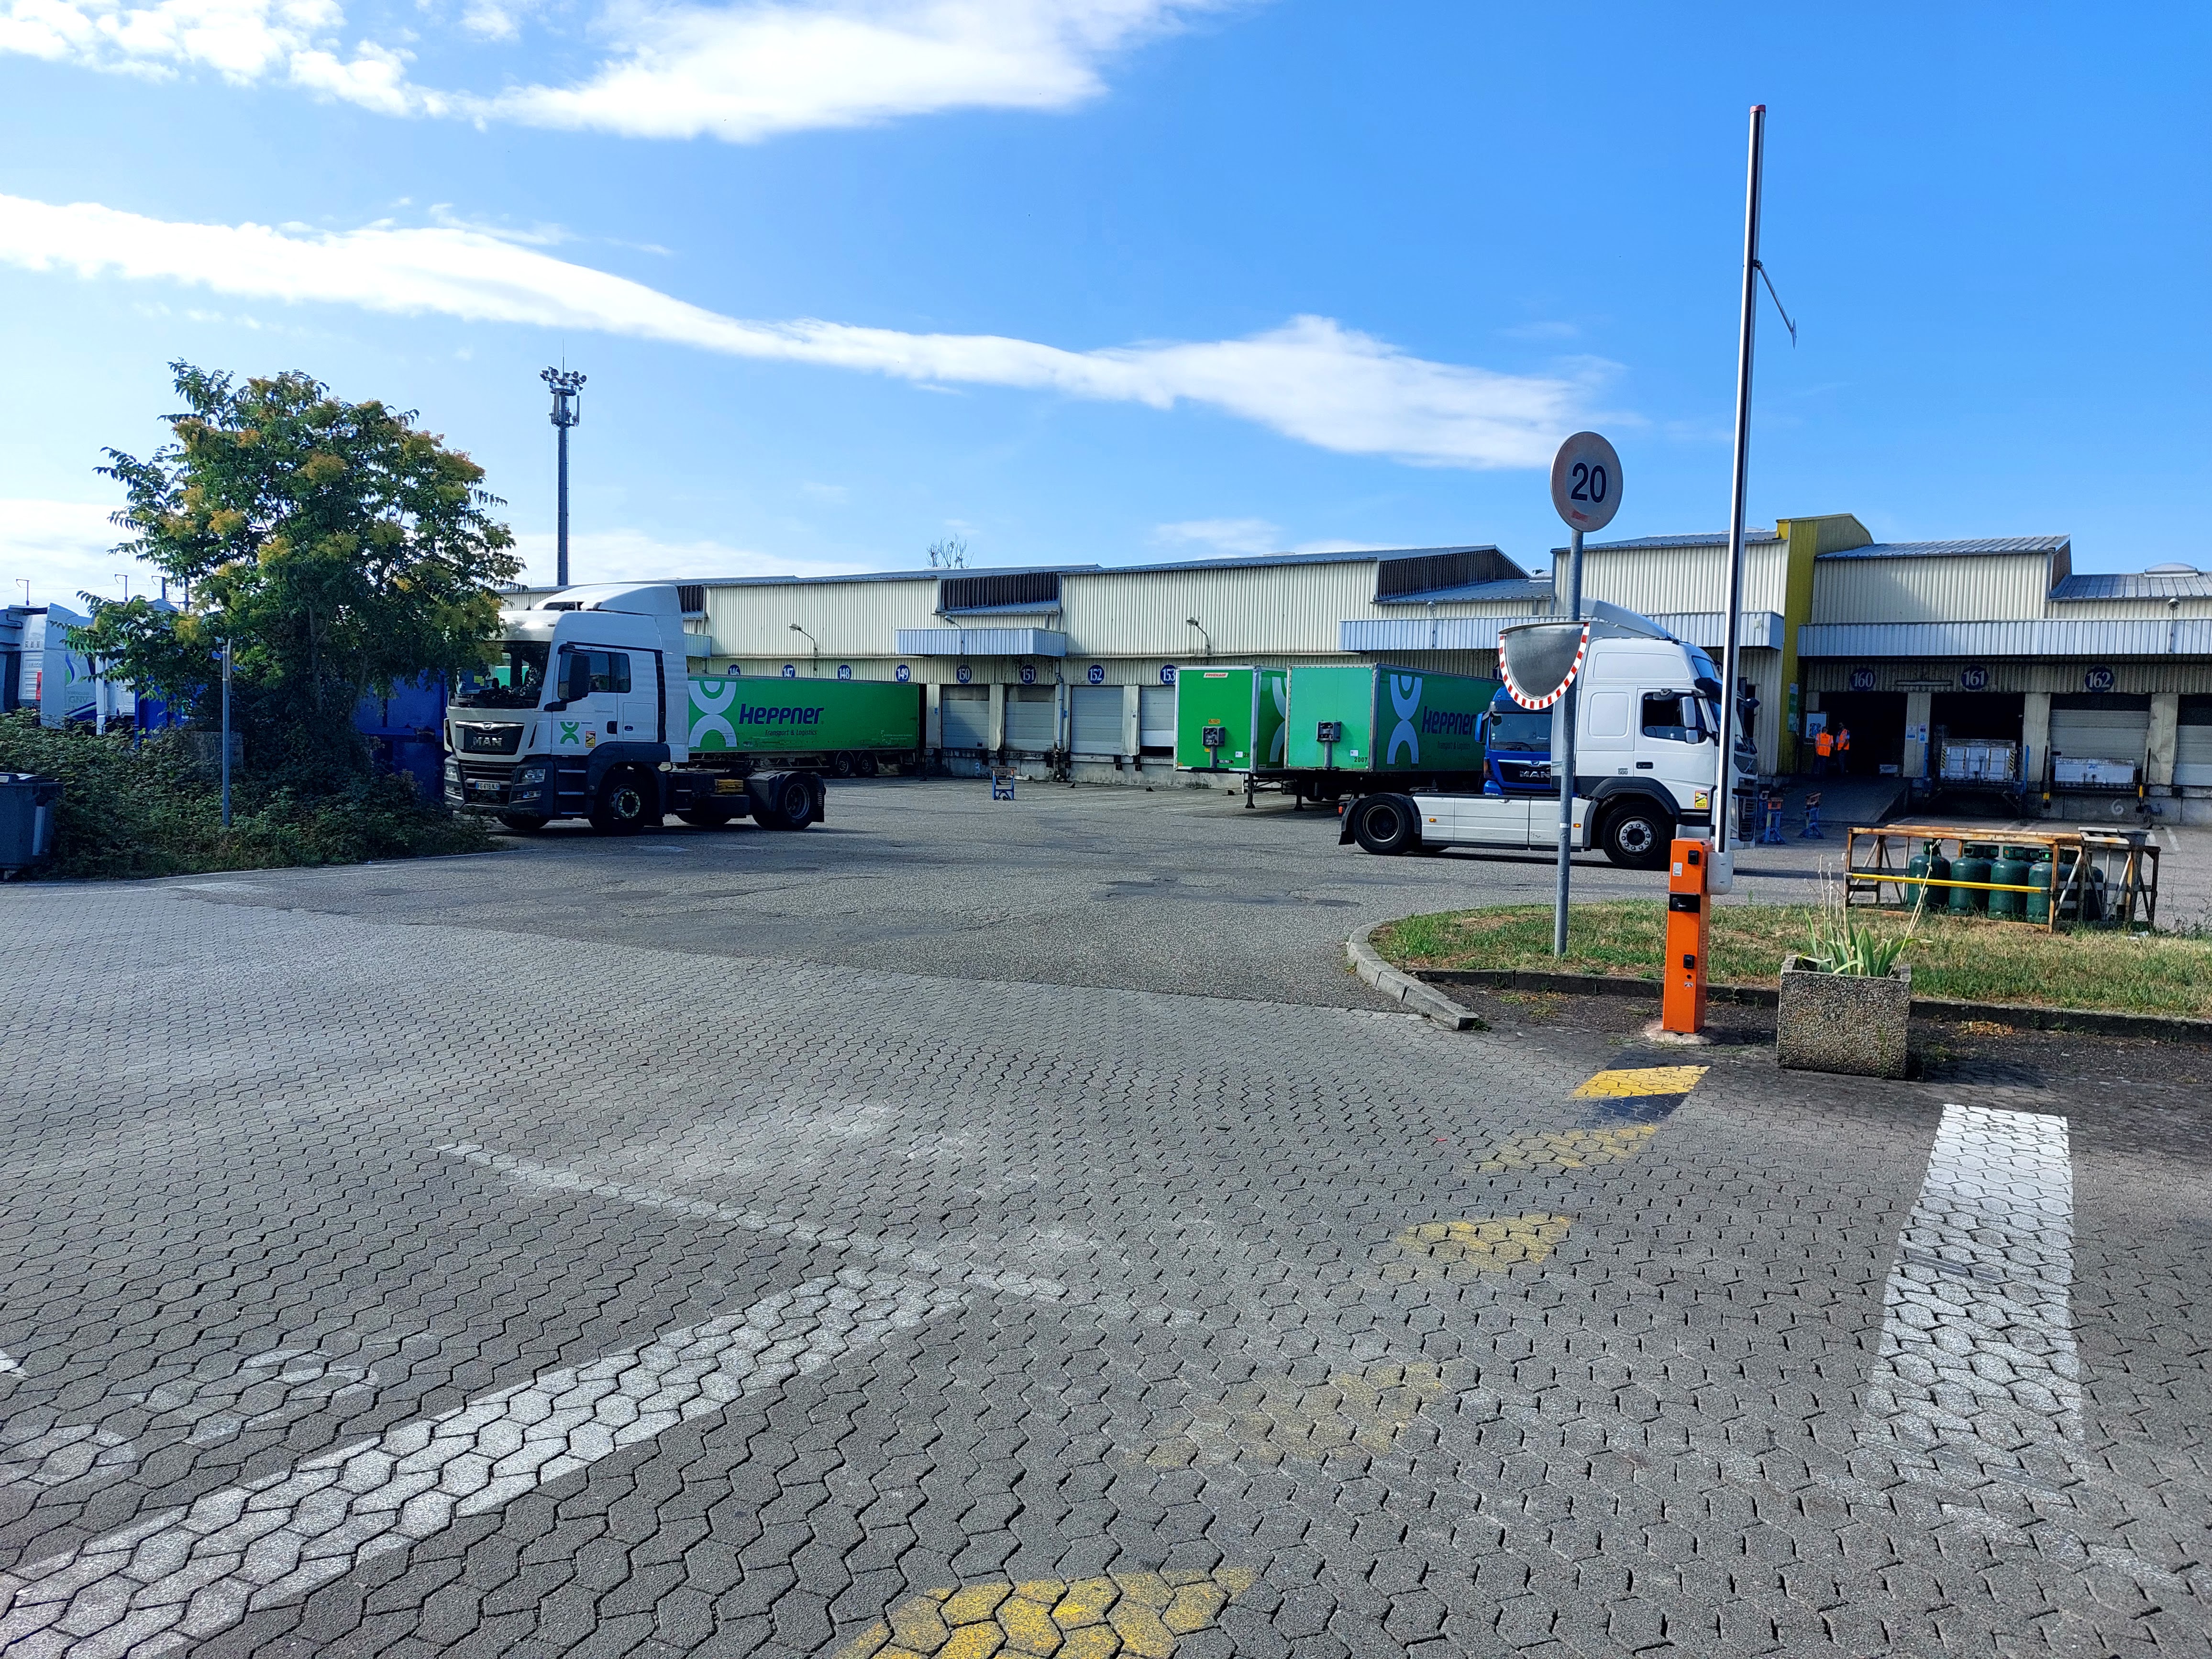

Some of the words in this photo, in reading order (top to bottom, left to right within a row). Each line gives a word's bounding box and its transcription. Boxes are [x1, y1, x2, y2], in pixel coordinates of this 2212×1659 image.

[1571, 462, 1606, 503] 20
[783, 668, 794, 677] 147
[839, 667, 850, 679] 148
[896, 668, 908, 680] 149
[958, 668, 970, 680] 150
[1021, 668, 1034, 681] 151
[1089, 668, 1102, 681] 152
[1162, 668, 1175, 681] 153
[1963, 670, 1985, 686] 161
[1853, 672, 1873, 687] 160
[2087, 672, 2111, 688] 162
[739, 703, 824, 724] Heppner
[1421, 706, 1477, 735] Heppner
[473, 737, 502, 746] MAN
[2111, 798, 2124, 815] 6
